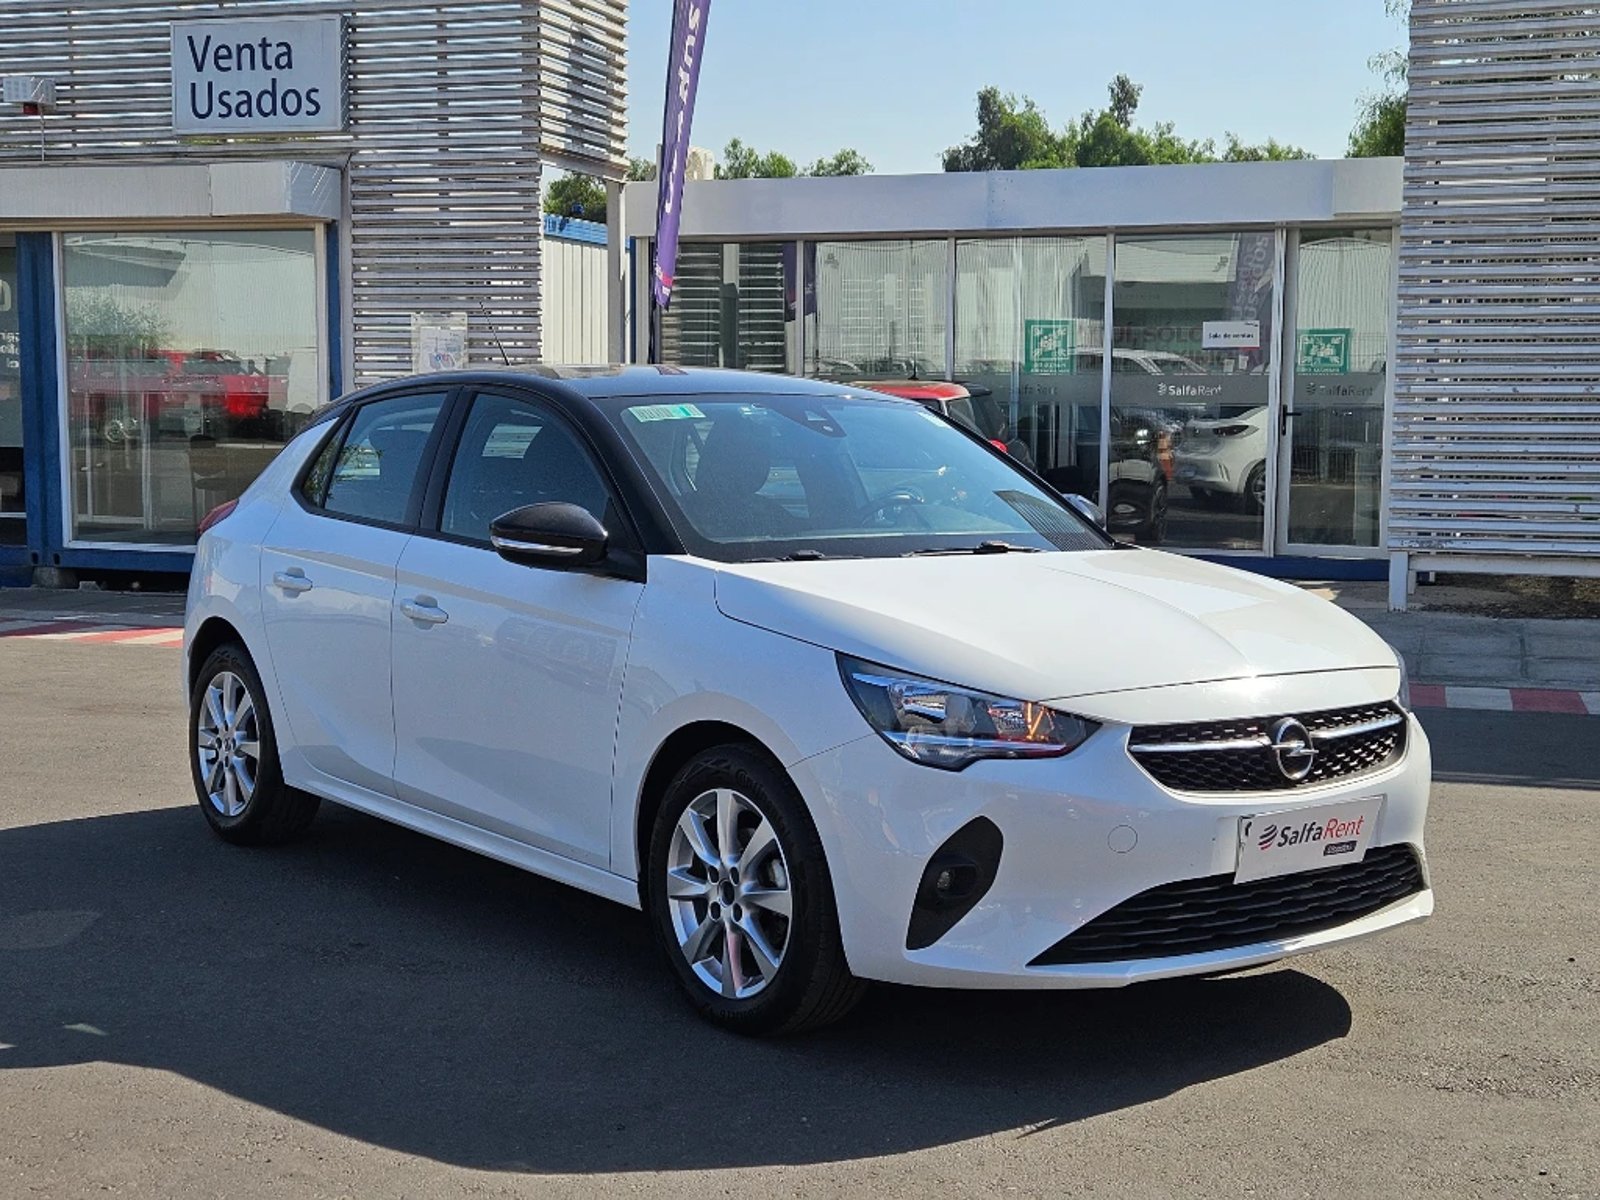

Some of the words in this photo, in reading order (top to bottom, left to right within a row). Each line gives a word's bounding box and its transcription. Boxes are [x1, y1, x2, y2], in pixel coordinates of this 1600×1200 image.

[187, 35, 293, 72] Venta
[190, 78, 321, 119] Usados
[1168, 384, 1222, 397] SalfaRent
[1277, 815, 1364, 847] SalfaRent
